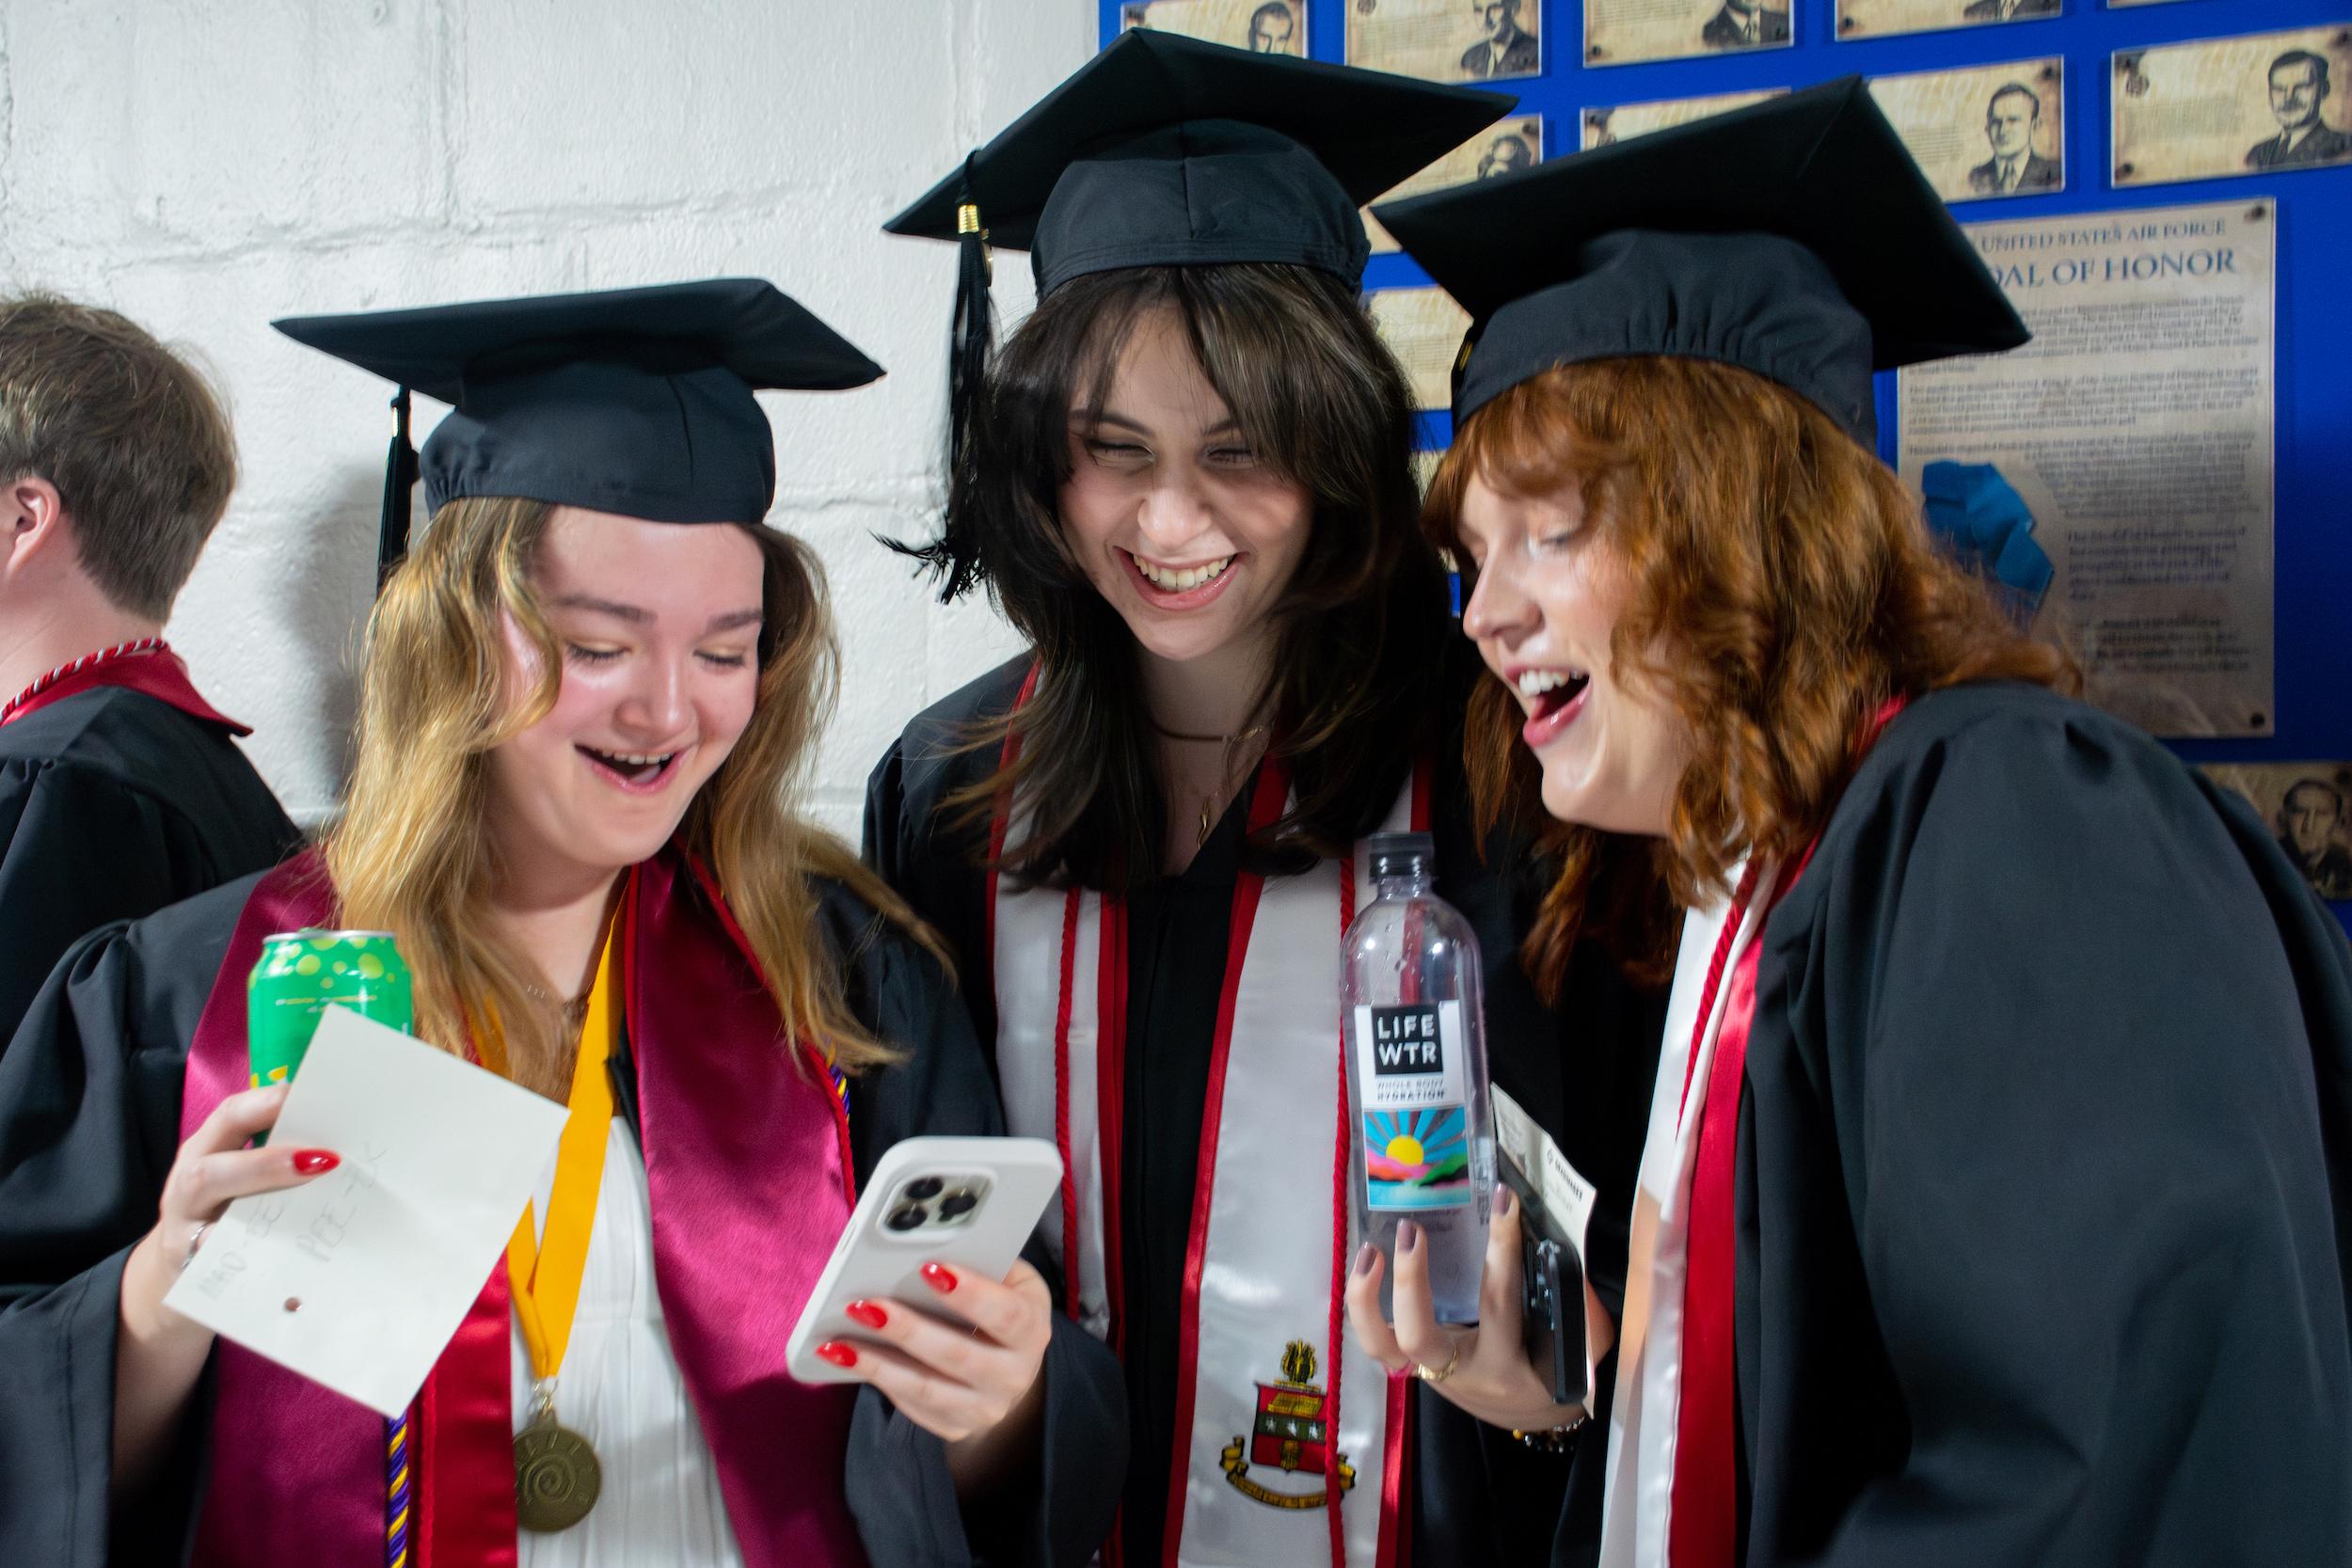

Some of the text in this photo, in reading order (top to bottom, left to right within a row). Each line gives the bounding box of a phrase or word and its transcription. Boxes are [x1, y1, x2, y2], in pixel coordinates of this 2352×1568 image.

[1981, 232, 2054, 253] UNITED
[2128, 223, 2158, 242] AIR
[1992, 246, 2237, 288] DAL OF HONOR
[1377, 1014, 1435, 1039] LIFE
[1378, 1041, 1437, 1067] WTR
[1377, 1089, 1445, 1101] HYDRATION
